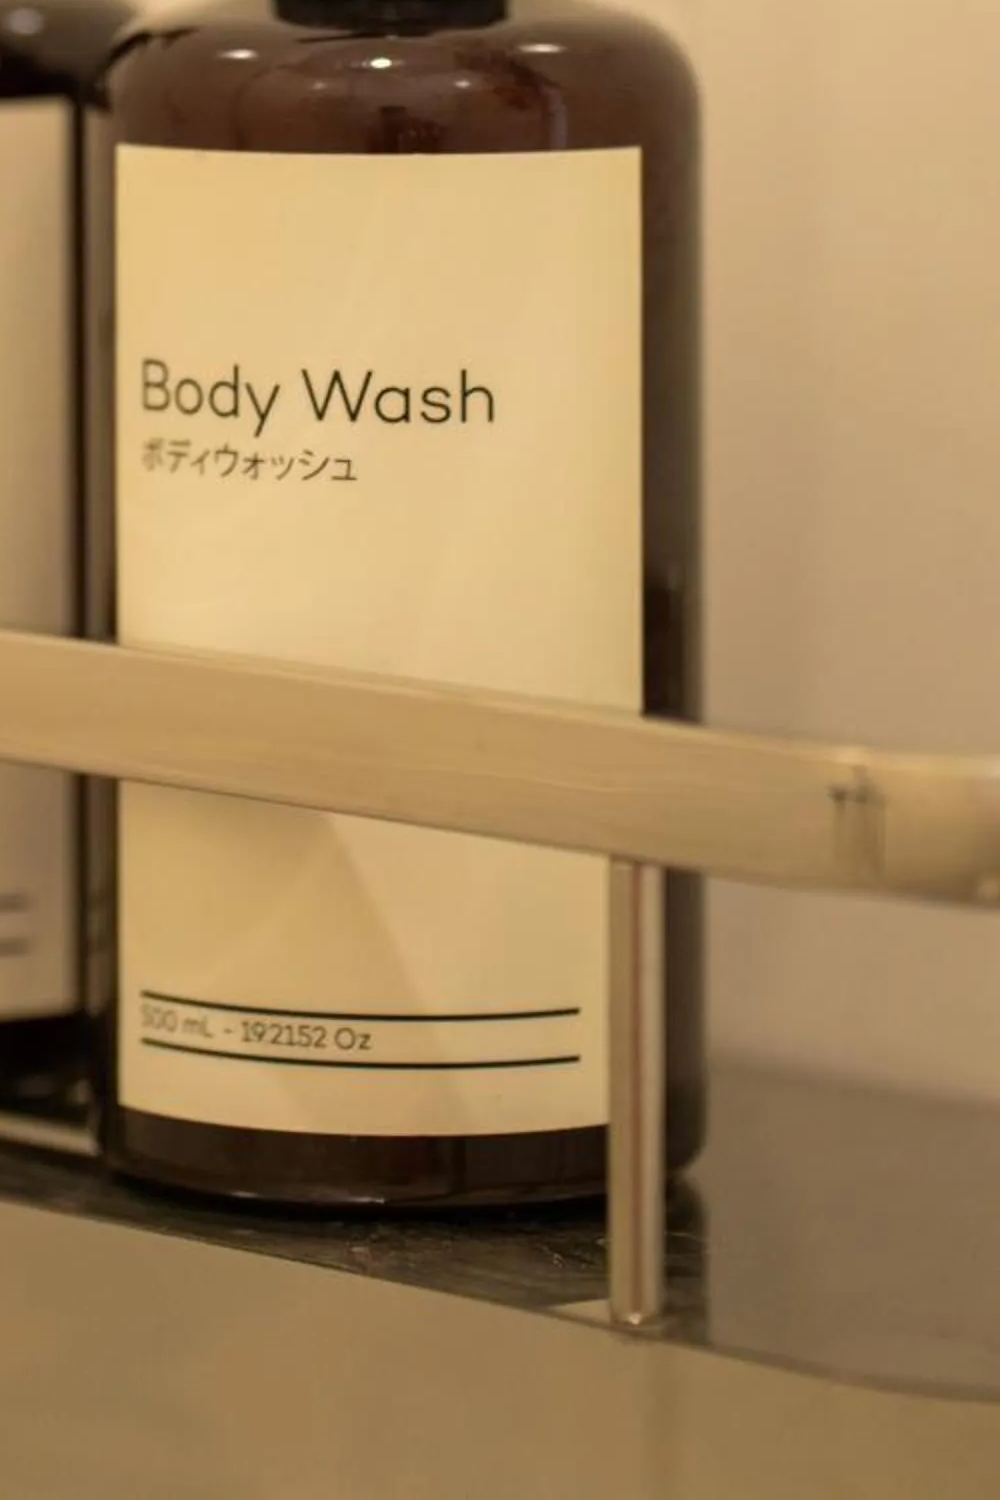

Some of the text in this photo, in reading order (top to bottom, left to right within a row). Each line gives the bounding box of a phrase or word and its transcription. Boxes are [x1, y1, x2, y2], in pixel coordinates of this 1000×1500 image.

[141, 357, 495, 438] Body Wash
[141, 438, 358, 482] ボディウォッシュ
[182, 1014, 215, 1039] mL
[241, 1020, 328, 1049] 192152
[333, 1026, 373, 1051] Oz
